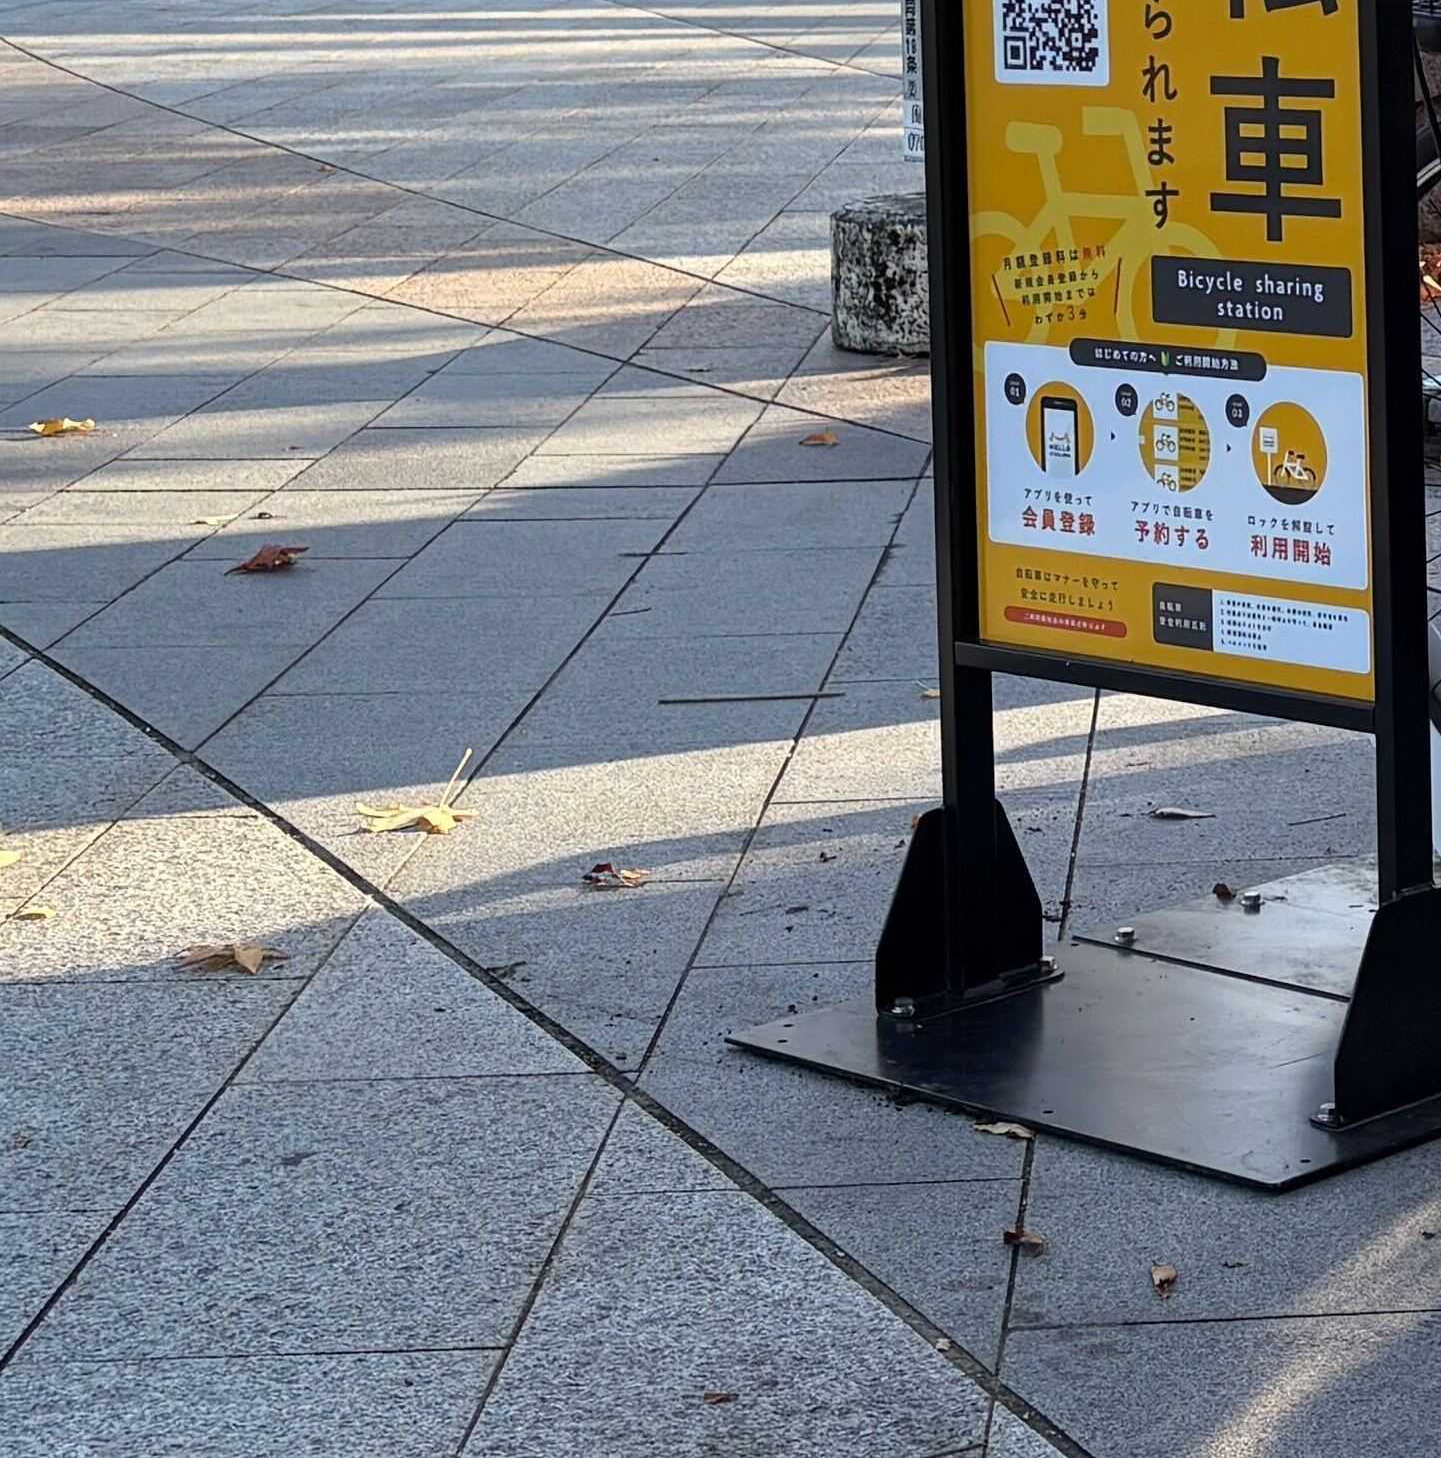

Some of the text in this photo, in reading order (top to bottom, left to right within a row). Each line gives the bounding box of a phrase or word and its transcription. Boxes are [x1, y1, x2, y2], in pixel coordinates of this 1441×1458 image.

[1177, 269, 1324, 302] Bicycle sharing
[1217, 299, 1284, 322] station
[1022, 505, 1096, 536] 会員登録
[1130, 501, 1214, 521] アプリで自転車を
[1134, 519, 1210, 550] 予約する
[1250, 534, 1332, 566] 利用開始
